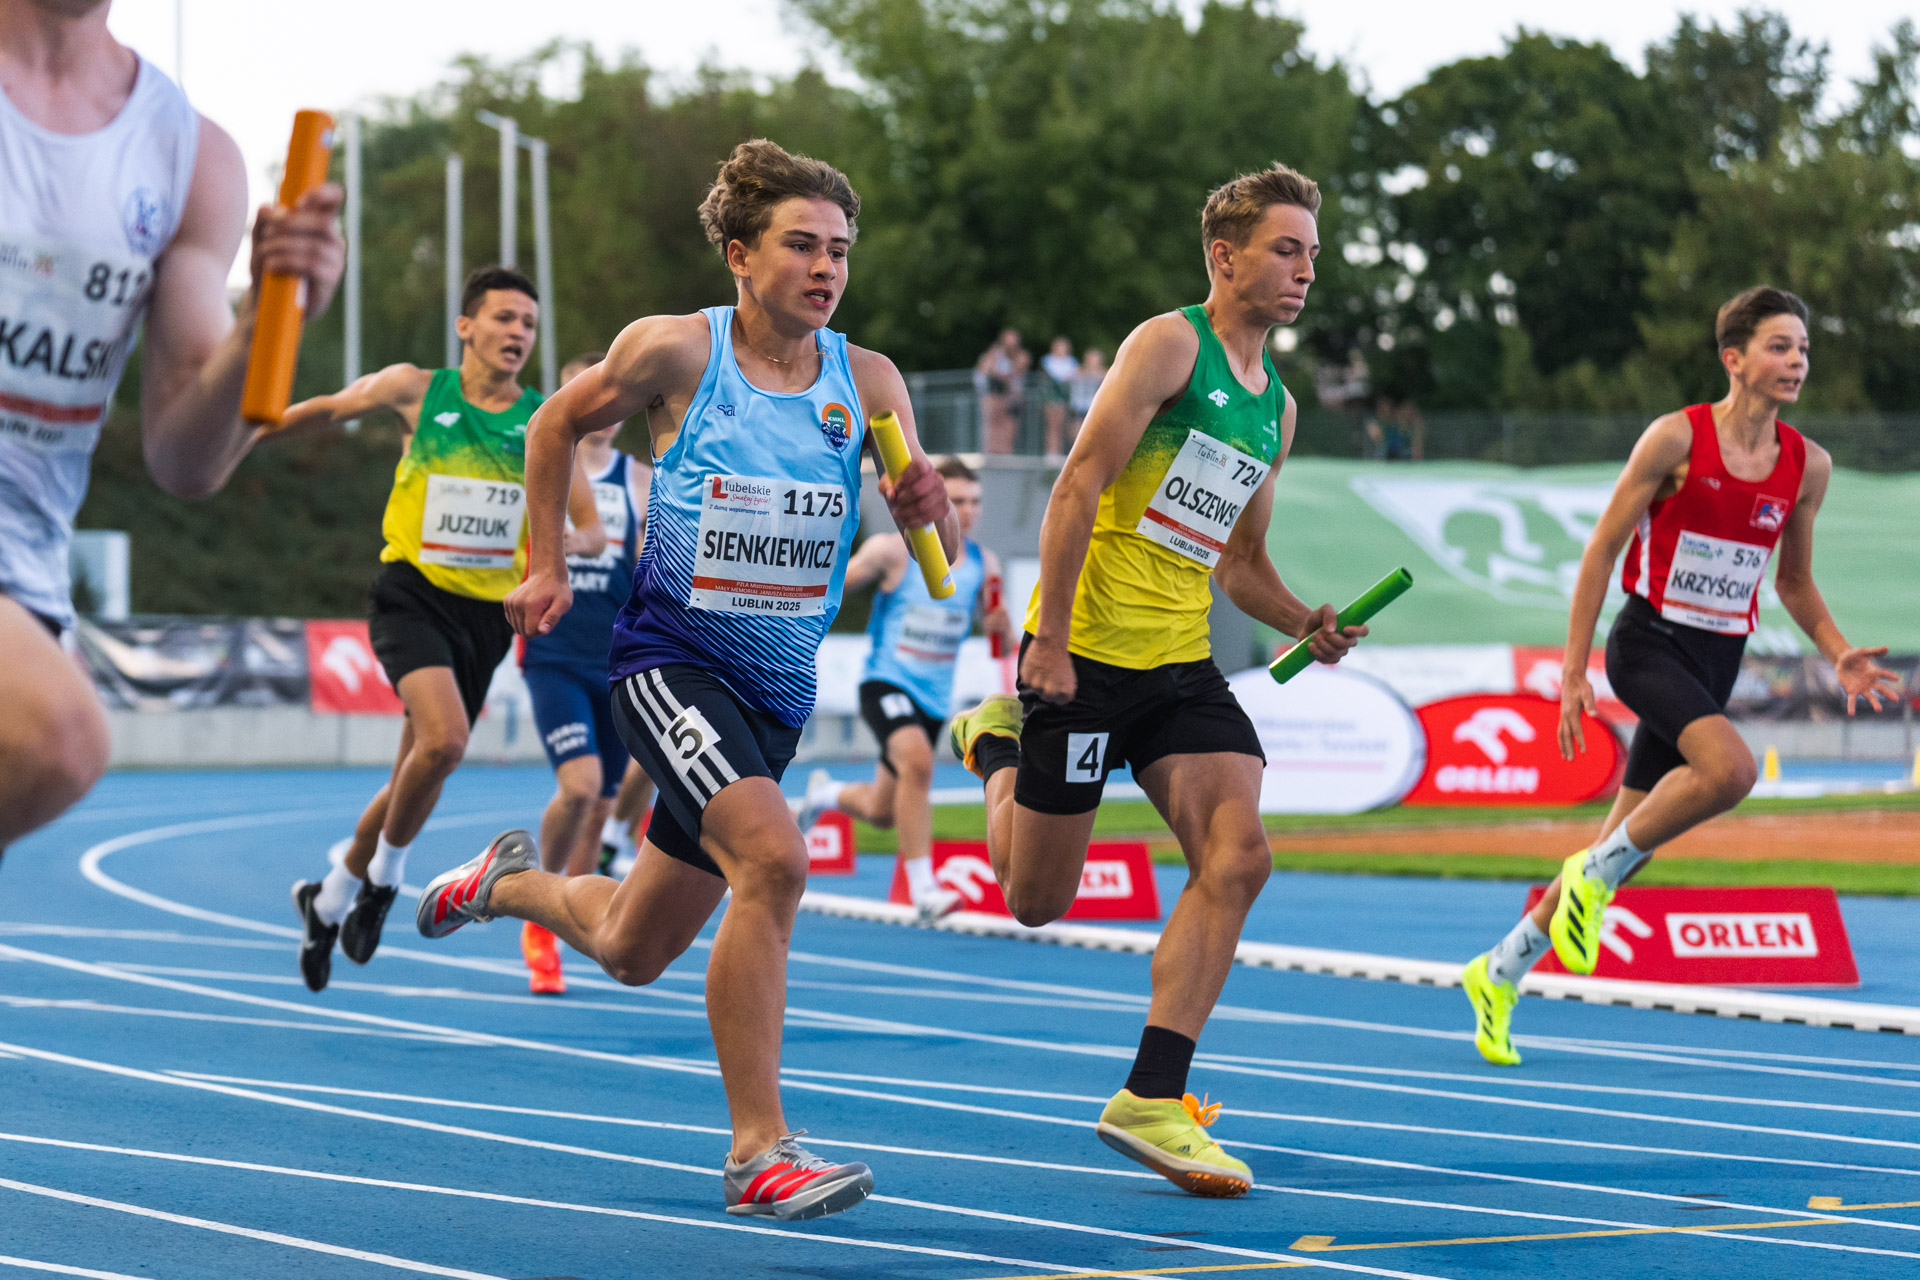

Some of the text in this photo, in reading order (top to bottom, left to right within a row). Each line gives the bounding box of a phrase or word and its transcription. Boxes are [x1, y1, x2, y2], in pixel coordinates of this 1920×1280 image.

[1231, 459, 1263, 488] 724
[486, 486, 520, 505] 719
[725, 481, 771, 496] lubelskie
[783, 489, 843, 518] 1175
[437, 514, 509, 537] JUZIUK
[703, 529, 835, 569] SIENKIEWICZ
[1169, 536, 1195, 553] LUBLIN
[1193, 547, 1210, 559] 2025
[1732, 548, 1761, 568] 576
[732, 597, 801, 611] LUBLIN 2025
[668, 716, 703, 760] 5
[1076, 737, 1099, 778] 4
[1434, 764, 1540, 794] ORLEN
[1679, 922, 1804, 948] ORLEN
